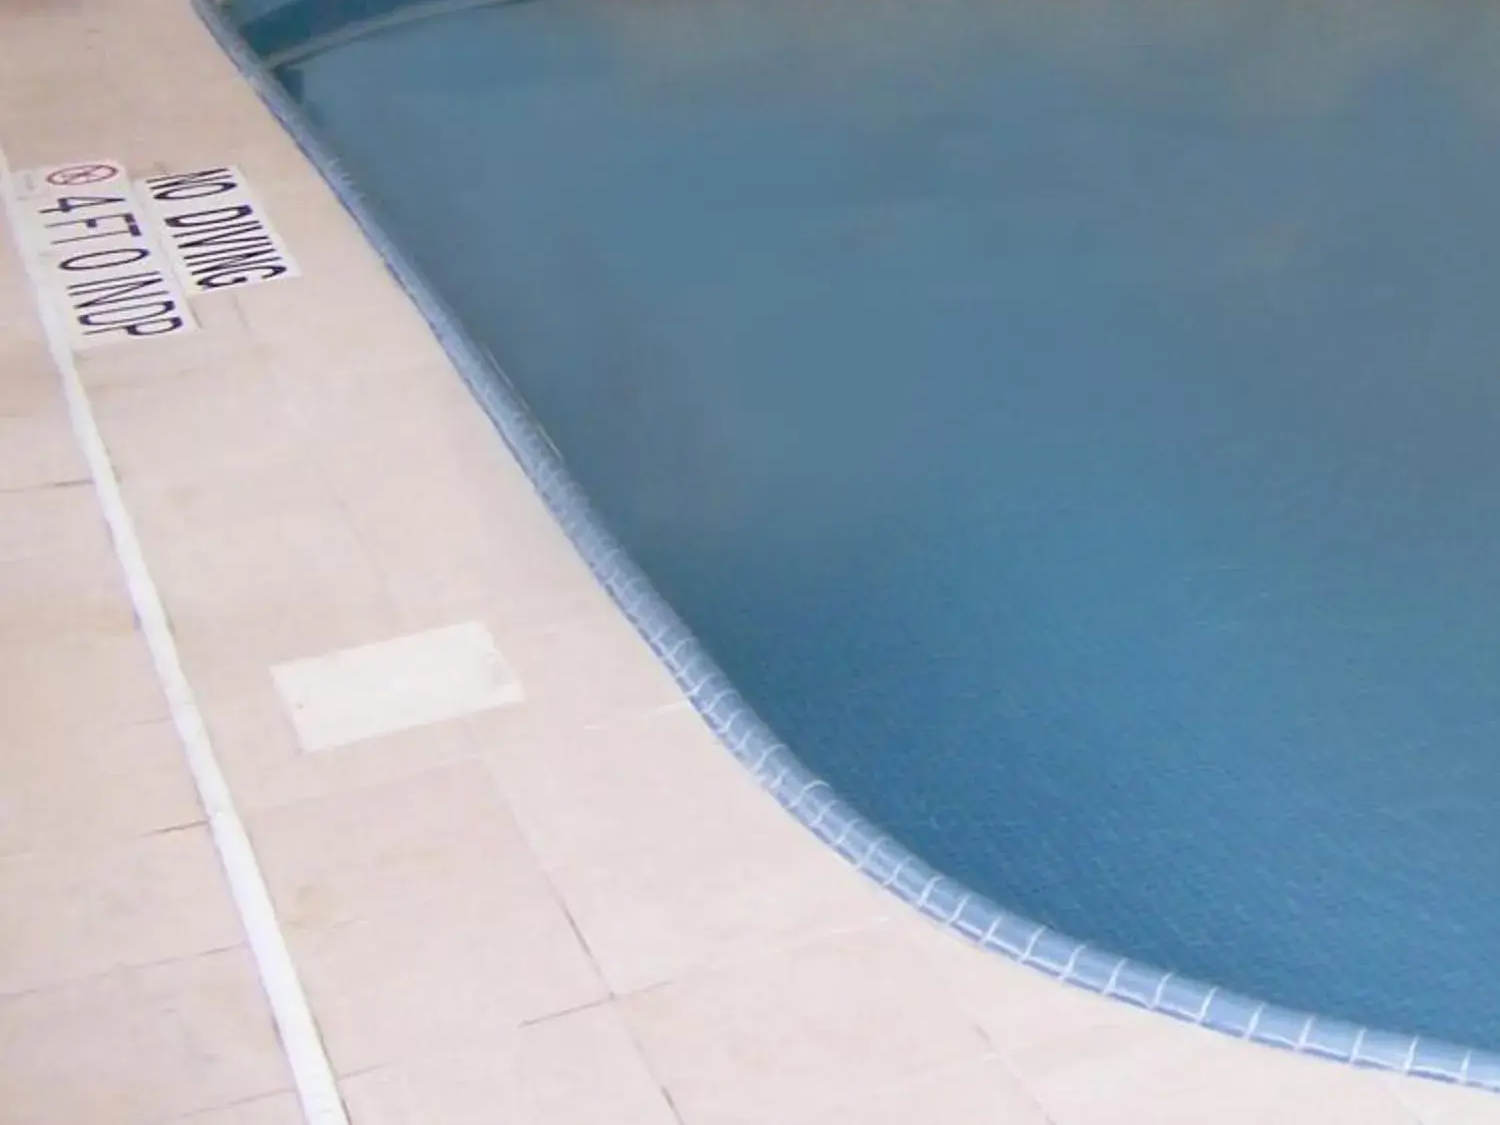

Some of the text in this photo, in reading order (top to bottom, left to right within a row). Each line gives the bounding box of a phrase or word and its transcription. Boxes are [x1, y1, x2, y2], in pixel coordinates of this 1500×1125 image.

[39, 196, 126, 213] 4
[45, 212, 142, 245] FT
[146, 167, 287, 288] NO DIVING
